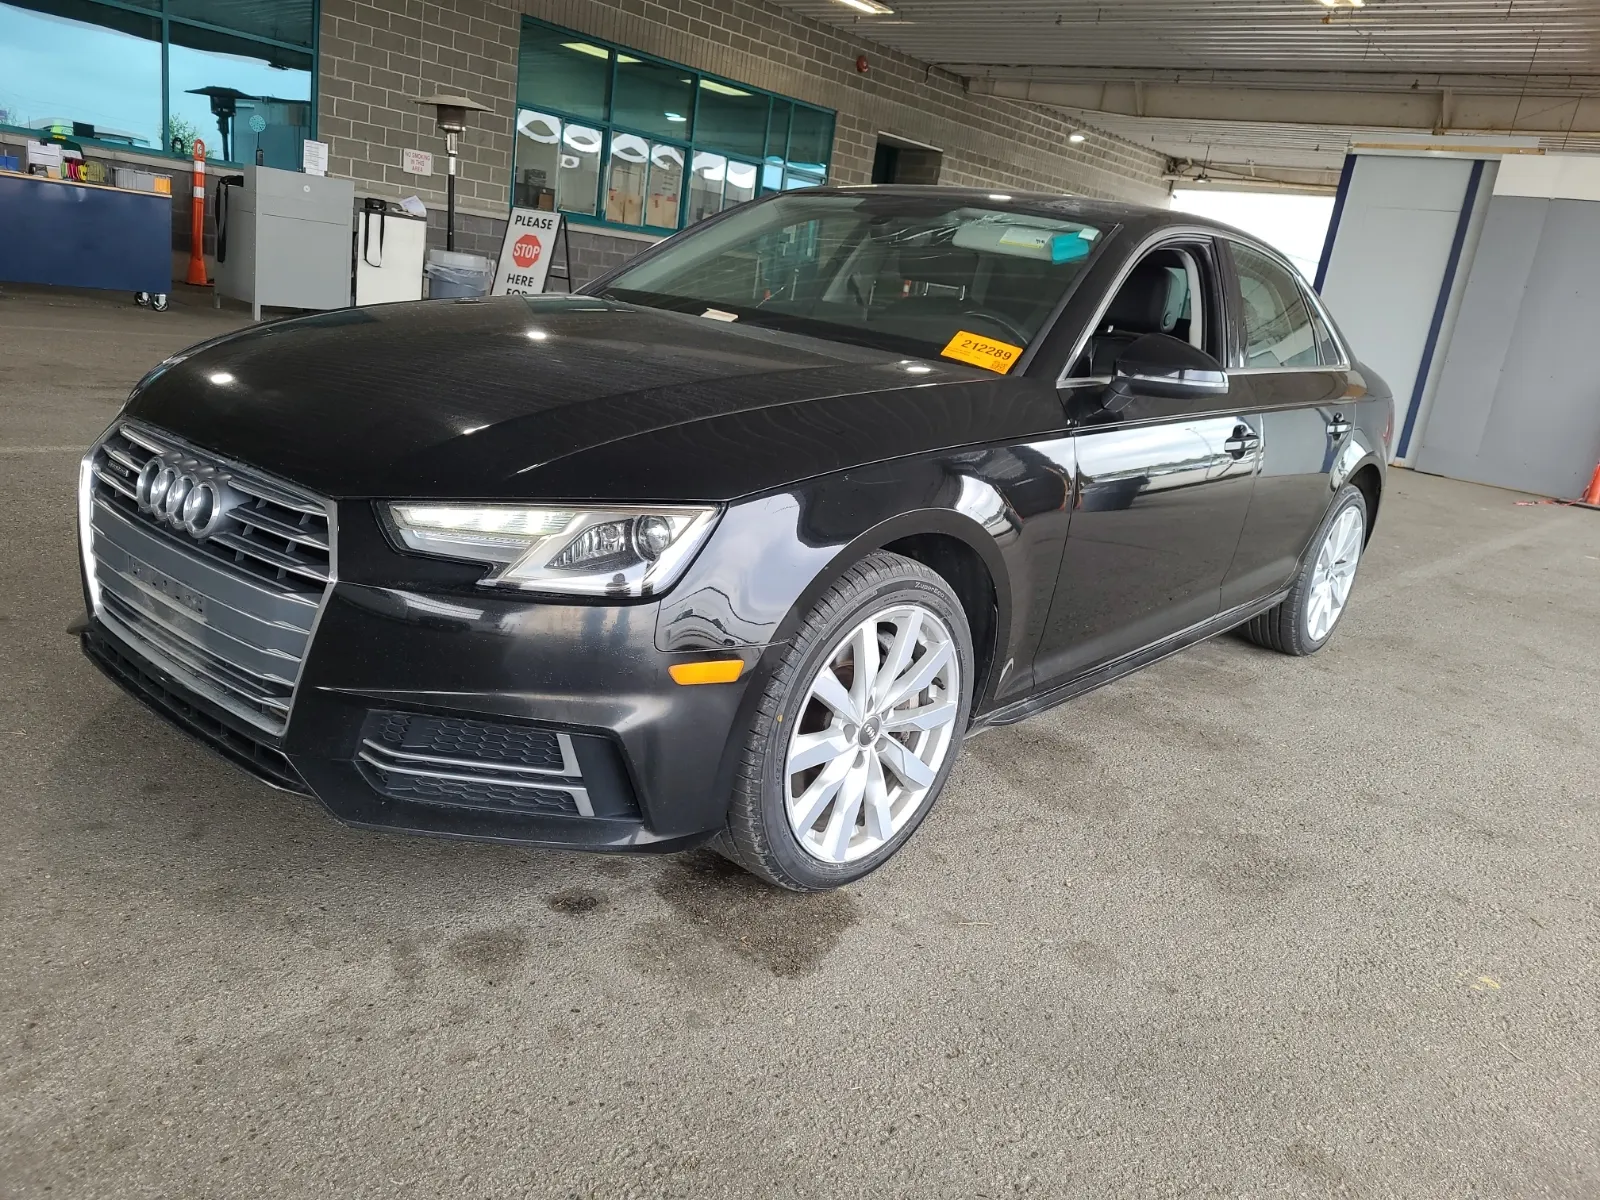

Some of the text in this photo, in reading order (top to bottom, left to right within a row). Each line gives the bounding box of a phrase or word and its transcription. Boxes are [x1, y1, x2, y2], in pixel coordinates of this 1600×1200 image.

[412, 152, 430, 161] SMOKING
[515, 215, 553, 230] PLEASE
[513, 243, 540, 259] STOP
[506, 273, 534, 287] HERE
[961, 339, 1012, 361] 212289
